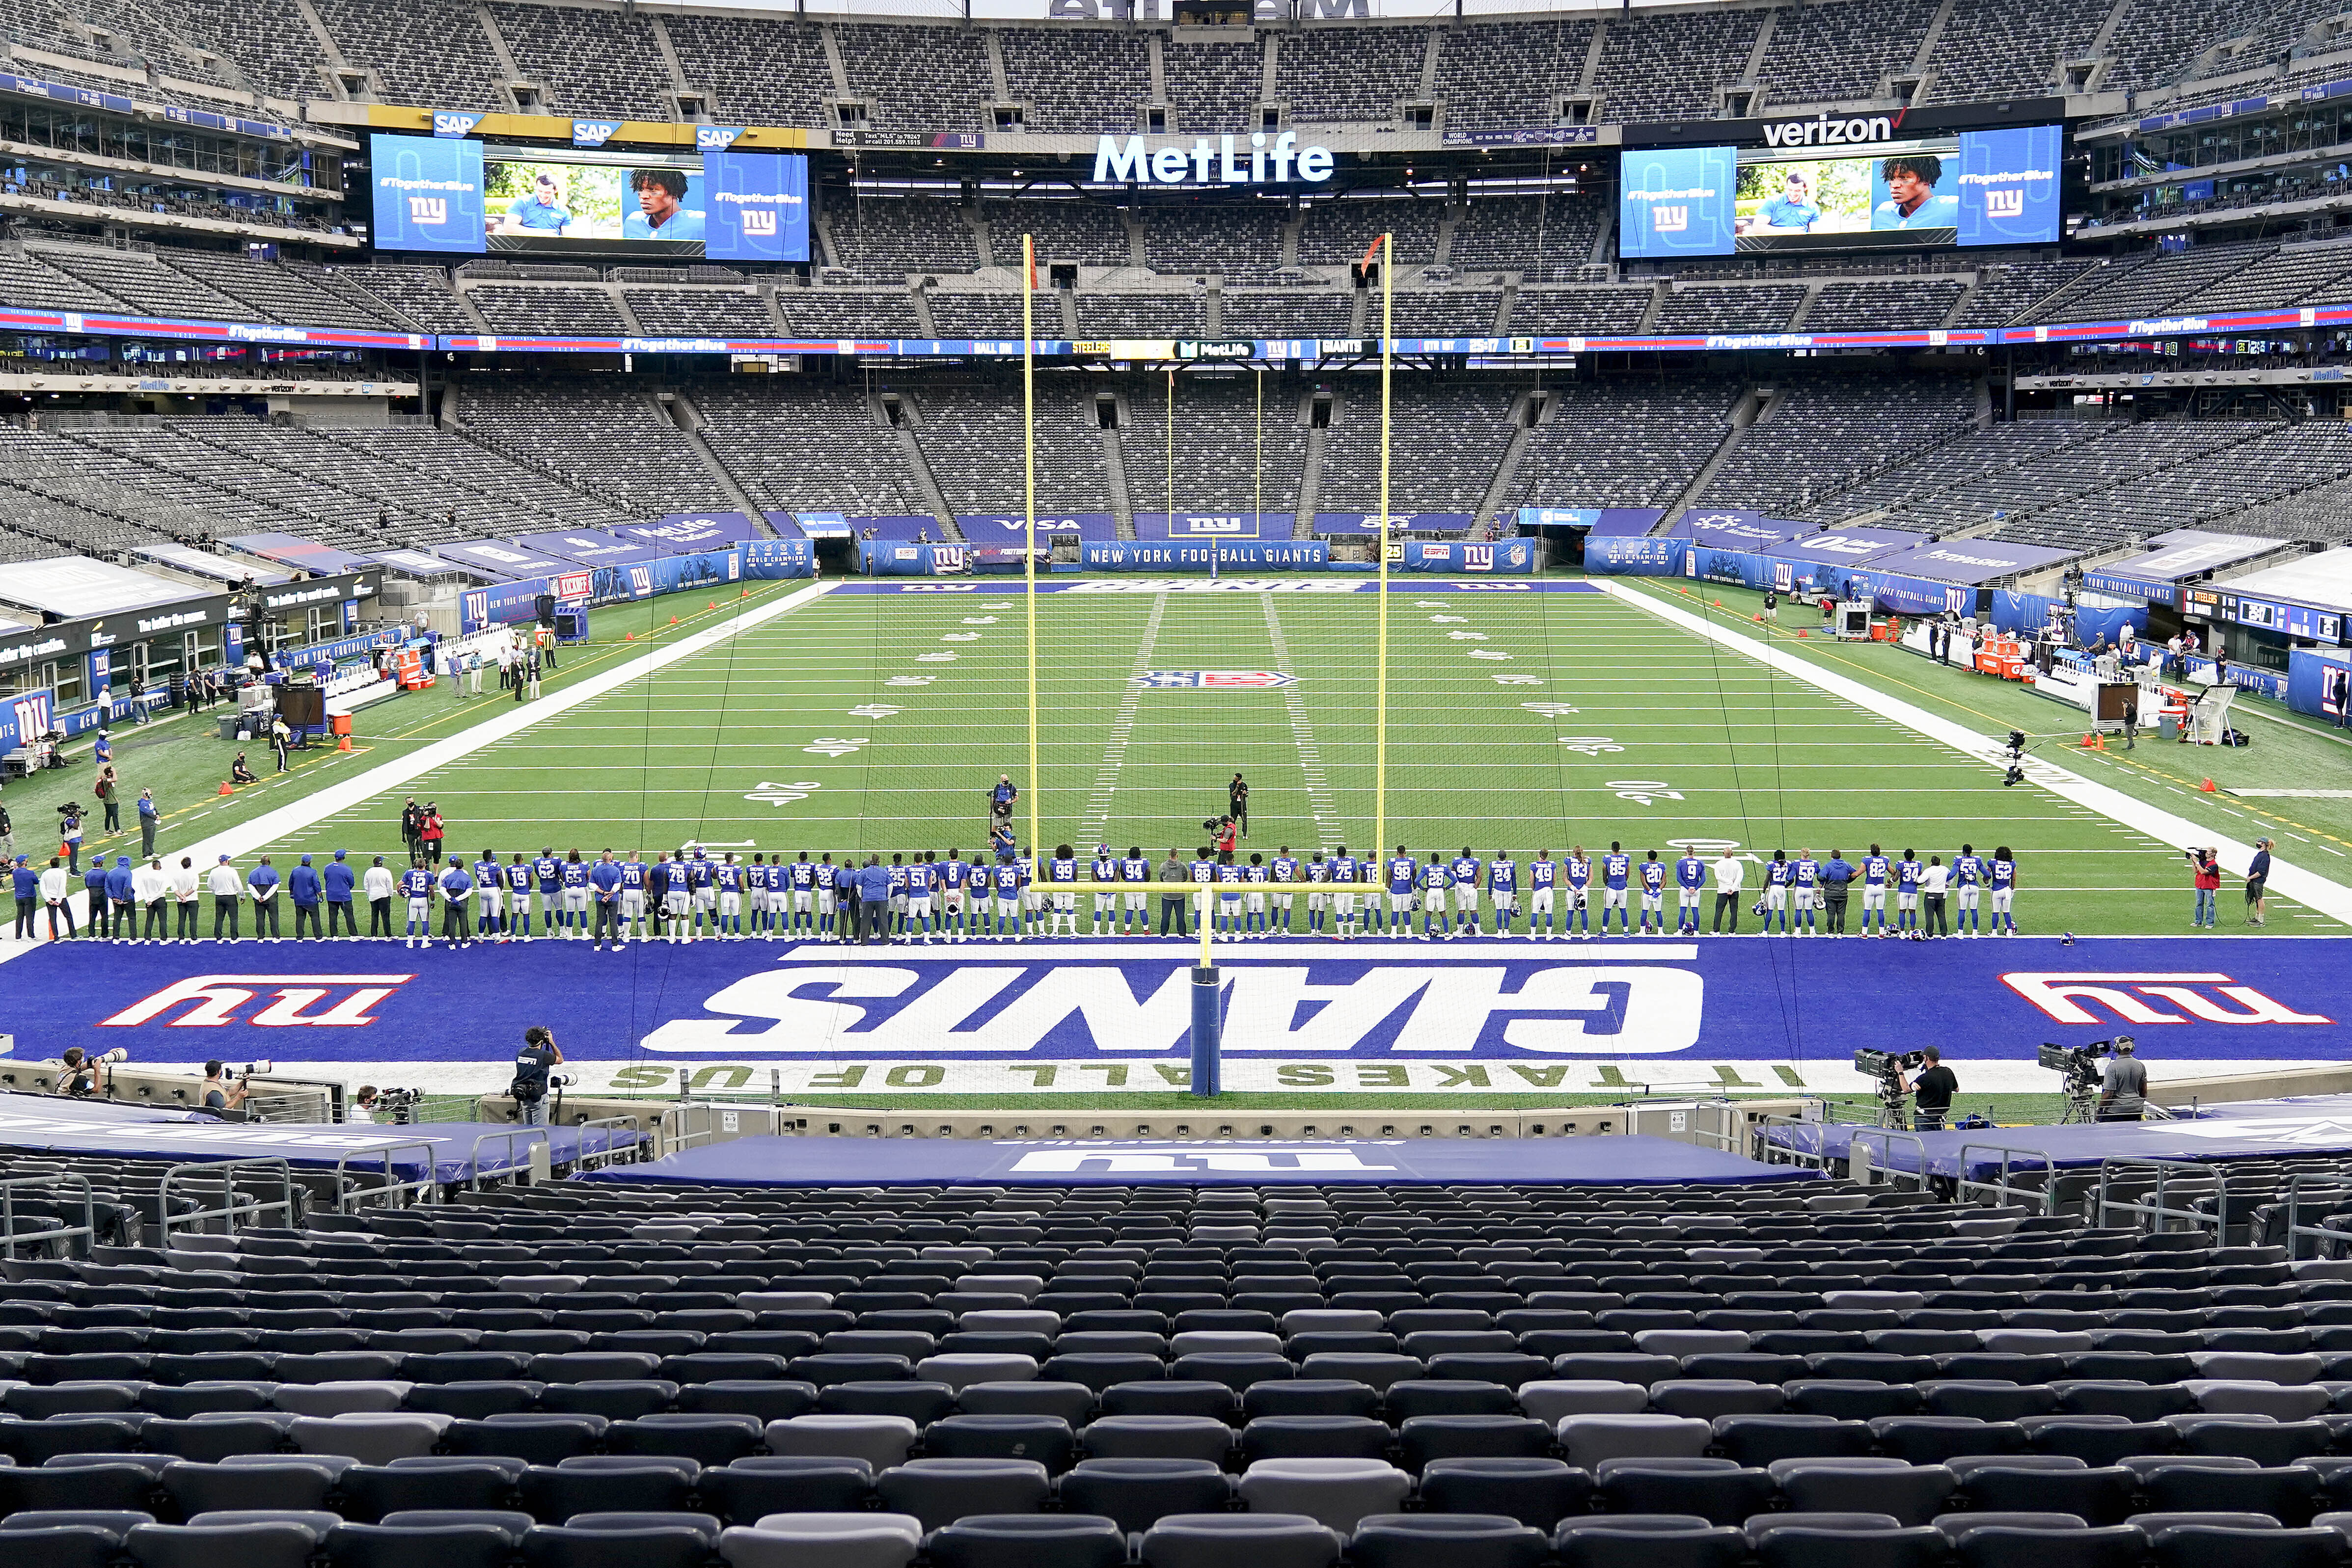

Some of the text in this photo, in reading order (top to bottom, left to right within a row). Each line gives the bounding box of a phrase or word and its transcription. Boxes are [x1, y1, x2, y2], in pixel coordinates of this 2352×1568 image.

[17, 80, 25, 89] 72
[81, 92, 88, 101] 76
[169, 109, 176, 118] 91
[435, 114, 474, 135] SAP
[1763, 114, 1890, 146] verizon
[574, 124, 612, 142] SAP
[697, 130, 735, 147] SAP
[1093, 131, 1334, 183] MetLife
[380, 177, 474, 191] #TogetherBlue
[1958, 170, 2053, 185] #TogetherBlue
[714, 192, 802, 204] #TogetherBlue
[1627, 188, 1715, 201] #TogetherBlue
[228, 325, 307, 341] #TogetherBlue
[2128, 317, 2208, 335] #TogetherBlue
[621, 338, 726, 352] #TogetherBlue
[974, 343, 997, 353] BALL
[1072, 341, 1110, 353] STEELERS
[1322, 340, 1362, 352] GIANTS
[1469, 339, 1499, 352] 25:17
[1706, 334, 1812, 349] #TogetherBlue
[1201, 343, 1249, 356] MetLife
[2313, 370, 2344, 381] MetLife
[140, 380, 169, 391] MetLife
[271, 384, 294, 393] verizon
[2049, 379, 2071, 387] verizon
[628, 518, 717, 538] MetLife
[1186, 517, 1241, 532] ny
[667, 529, 723, 542] Stadium
[933, 546, 964, 571] ny
[1091, 549, 1321, 563] NEW YORK FOOBALL GIANTS
[1387, 545, 1401, 559] 25
[1463, 545, 1495, 571] ny
[1513, 553, 1525, 562] NFL
[514, 560, 559, 570] TOYOTA
[630, 566, 652, 595] ny
[1775, 562, 1793, 592] ny
[561, 575, 588, 595] KICKOFF
[2088, 577, 2170, 600] YORK FOOTBALL GIANTS
[267, 591, 307, 608] The the
[1879, 587, 1944, 606] YORK FOOTBALL GIANTS
[2194, 591, 2217, 605] STEELERS
[465, 592, 488, 628] ny
[490, 599, 501, 610] NEW
[2193, 603, 2212, 617] GIANTS
[138, 619, 152, 633] The
[172, 613, 184, 626] the
[2323, 618, 2333, 636] 25
[230, 627, 241, 645] ny
[19, 643, 33, 659] the
[294, 651, 308, 667] NEW
[334, 640, 368, 657] FOOTBALL
[94, 655, 108, 676] ny
[13, 695, 49, 745] ny
[80, 711, 98, 730] NEW
[743, 781, 822, 801] 20
[1605, 780, 1685, 800] 20
[538, 865, 556, 878] 62
[949, 867, 957, 882] 8
[1056, 865, 1072, 879] 99
[1097, 865, 1114, 879] 44
[1126, 865, 1143, 879] 94
[1195, 868, 1211, 882] 88
[1275, 865, 1290, 877] 53
[1336, 866, 1352, 880] 75
[1394, 865, 1411, 880] 98
[1456, 864, 1473, 878] 95
[1494, 868, 1511, 883] 24
[1534, 868, 1552, 882] 49
[1571, 864, 1587, 878] 83
[1610, 861, 1626, 876] 85
[1646, 868, 1663, 883] 20
[1688, 865, 1696, 880] 9
[1798, 866, 1814, 881] 58
[1869, 863, 1886, 877] 82
[1903, 867, 1918, 882] 34
[1996, 865, 2012, 879] 52
[511, 872, 526, 884] 19
[565, 870, 582, 883] 65
[623, 870, 640, 884] 70
[668, 869, 685, 884] 78
[720, 871, 736, 885] 54
[750, 872, 764, 886] 87
[769, 873, 778, 887] 5
[795, 870, 811, 883] 86
[817, 871, 833, 884] 22
[911, 872, 926, 886] 51
[969, 872, 986, 887] 43
[1000, 872, 1015, 887] 39
[1222, 872, 1238, 882] 26
[1248, 872, 1264, 882] 30
[1428, 872, 1444, 886] 28
[411, 877, 426, 892] 12
[95, 974, 419, 1027] ny
[1997, 972, 2338, 1025] ny
[642, 965, 1703, 1054] GIANTS
[517, 1055, 538, 1065] ESPN
[607, 1064, 1807, 1088] IT TAKES OF US
[107, 1129, 411, 1147] BUD
[1008, 1148, 1398, 1172] ny
